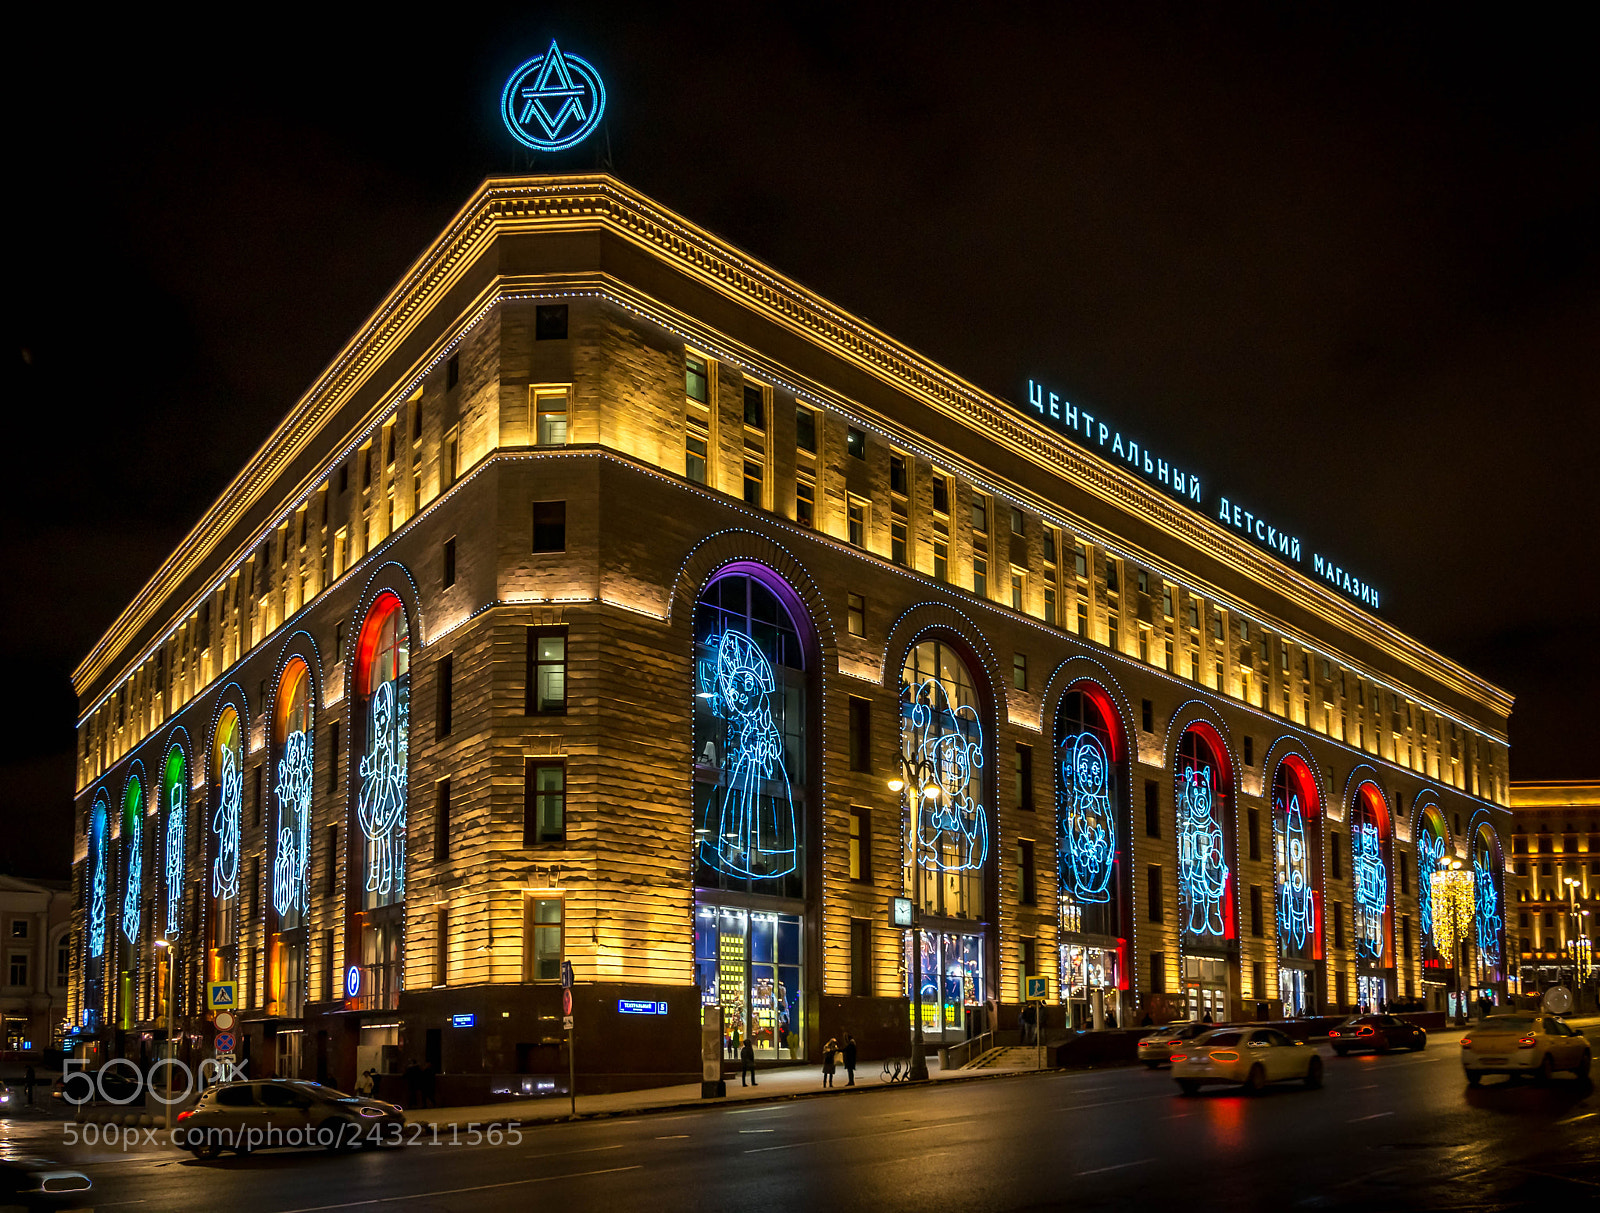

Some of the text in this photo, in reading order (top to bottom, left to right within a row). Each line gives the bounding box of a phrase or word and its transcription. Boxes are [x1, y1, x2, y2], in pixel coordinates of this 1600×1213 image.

[1028, 379, 1380, 609] ЦЕНТРАЛЬНЫЙ ДЕТСКИЙ МАГАЗИН
